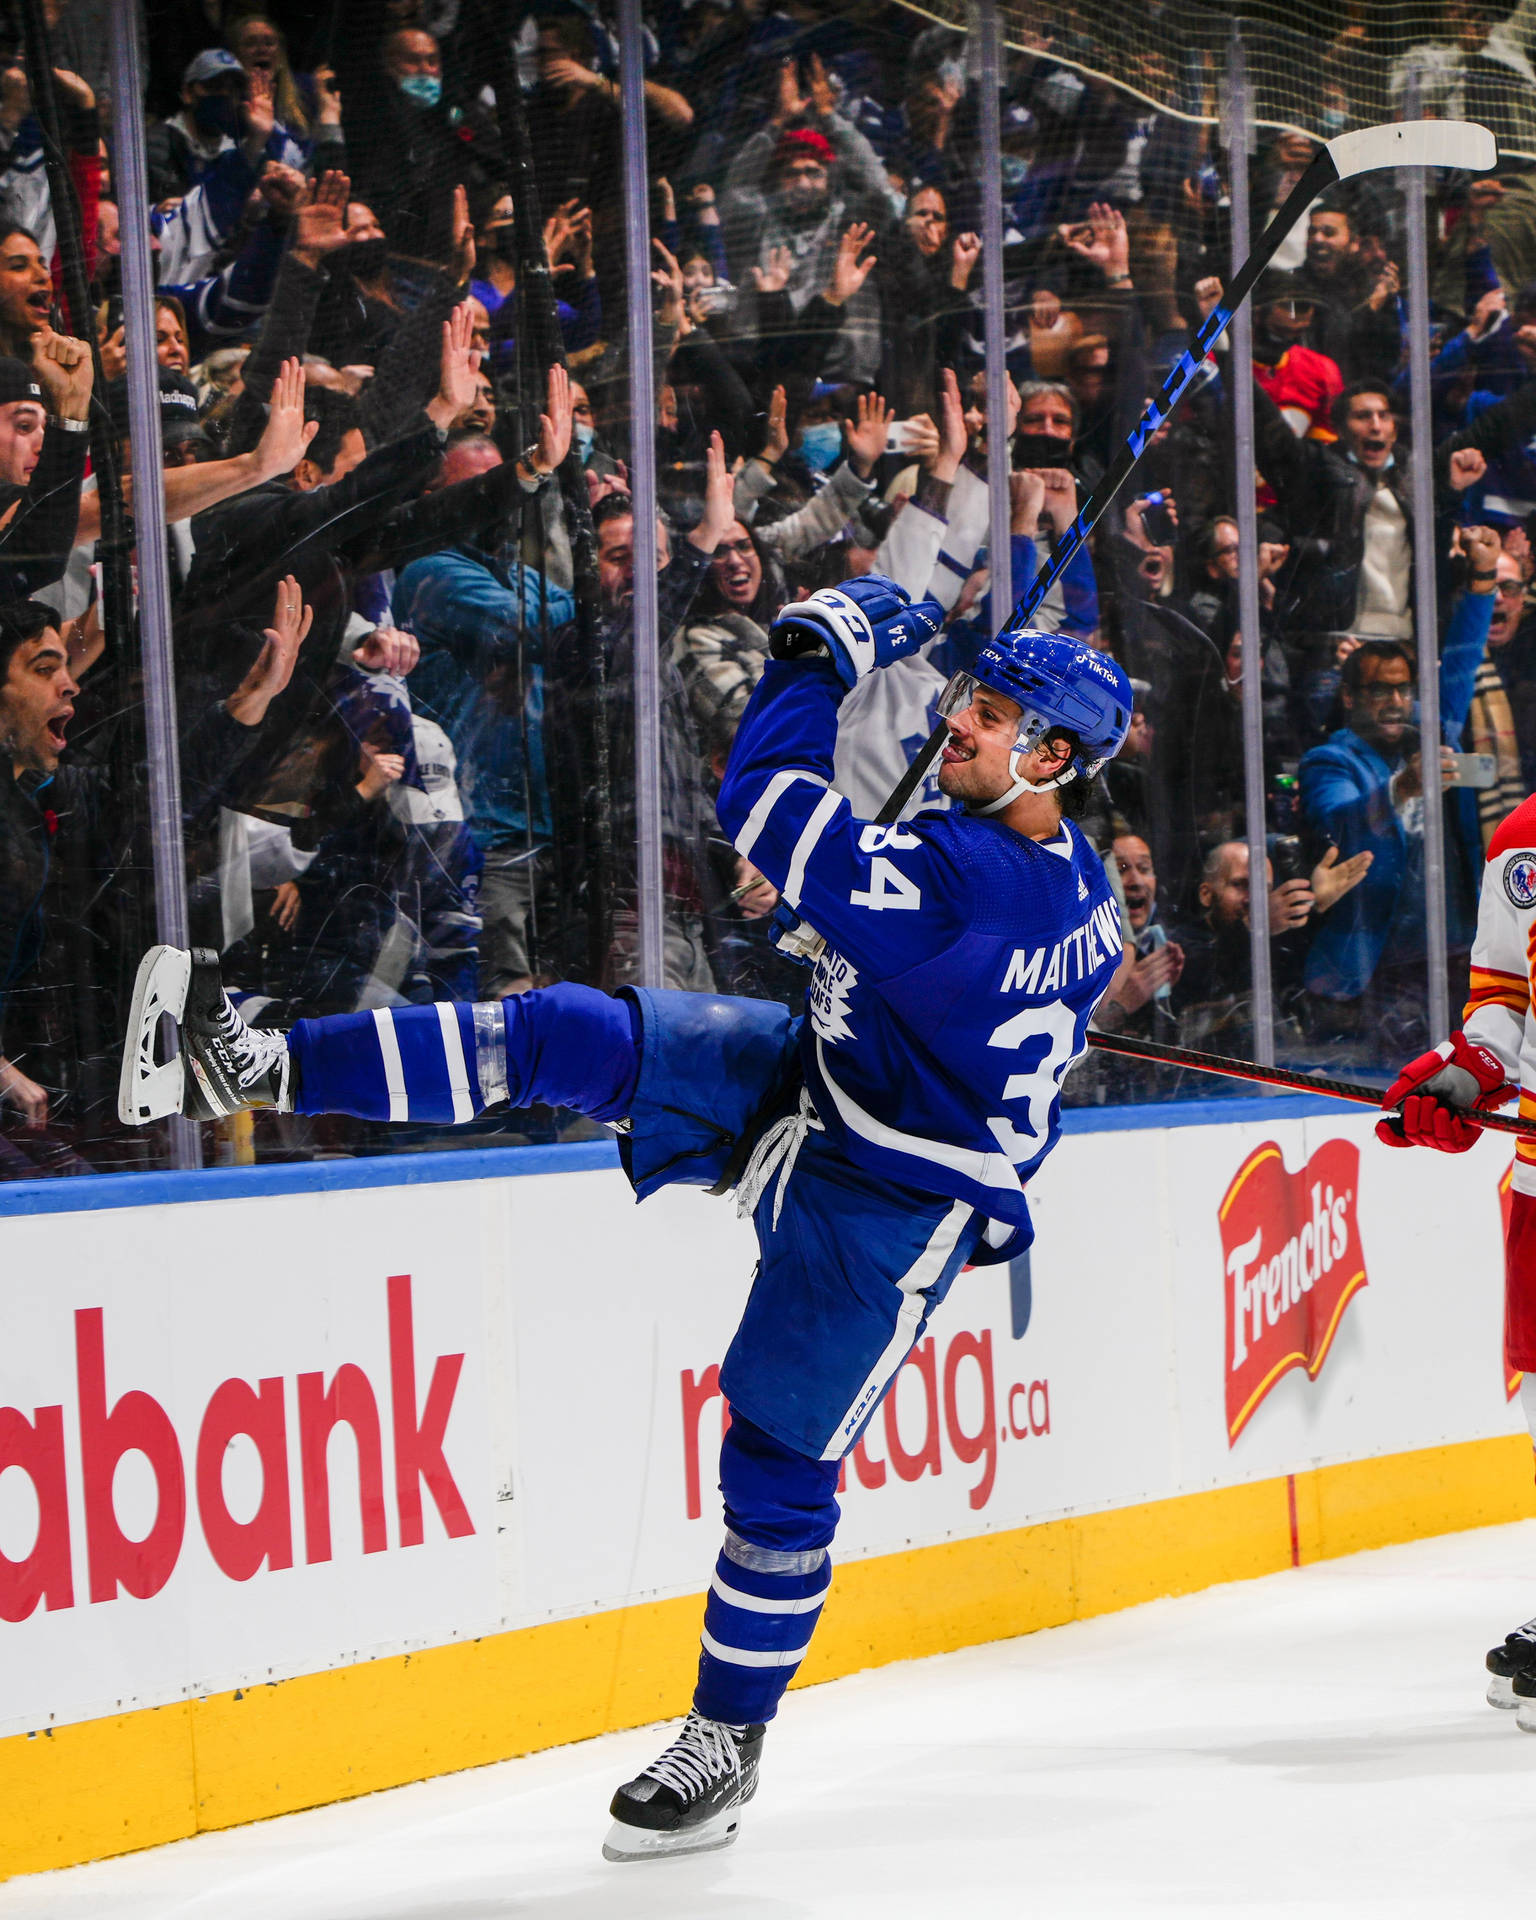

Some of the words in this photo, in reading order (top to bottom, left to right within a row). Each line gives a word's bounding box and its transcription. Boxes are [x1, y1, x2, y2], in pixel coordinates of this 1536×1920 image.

[1126, 305, 1232, 460] CCM
[887, 624, 908, 648] 34
[916, 612, 937, 632] CCM
[849, 822, 923, 911] 34
[211, 1036, 237, 1074] CCM
[986, 997, 1090, 1165] 3
[1226, 1181, 1349, 1371] French's
[845, 1385, 878, 1436] CCM
